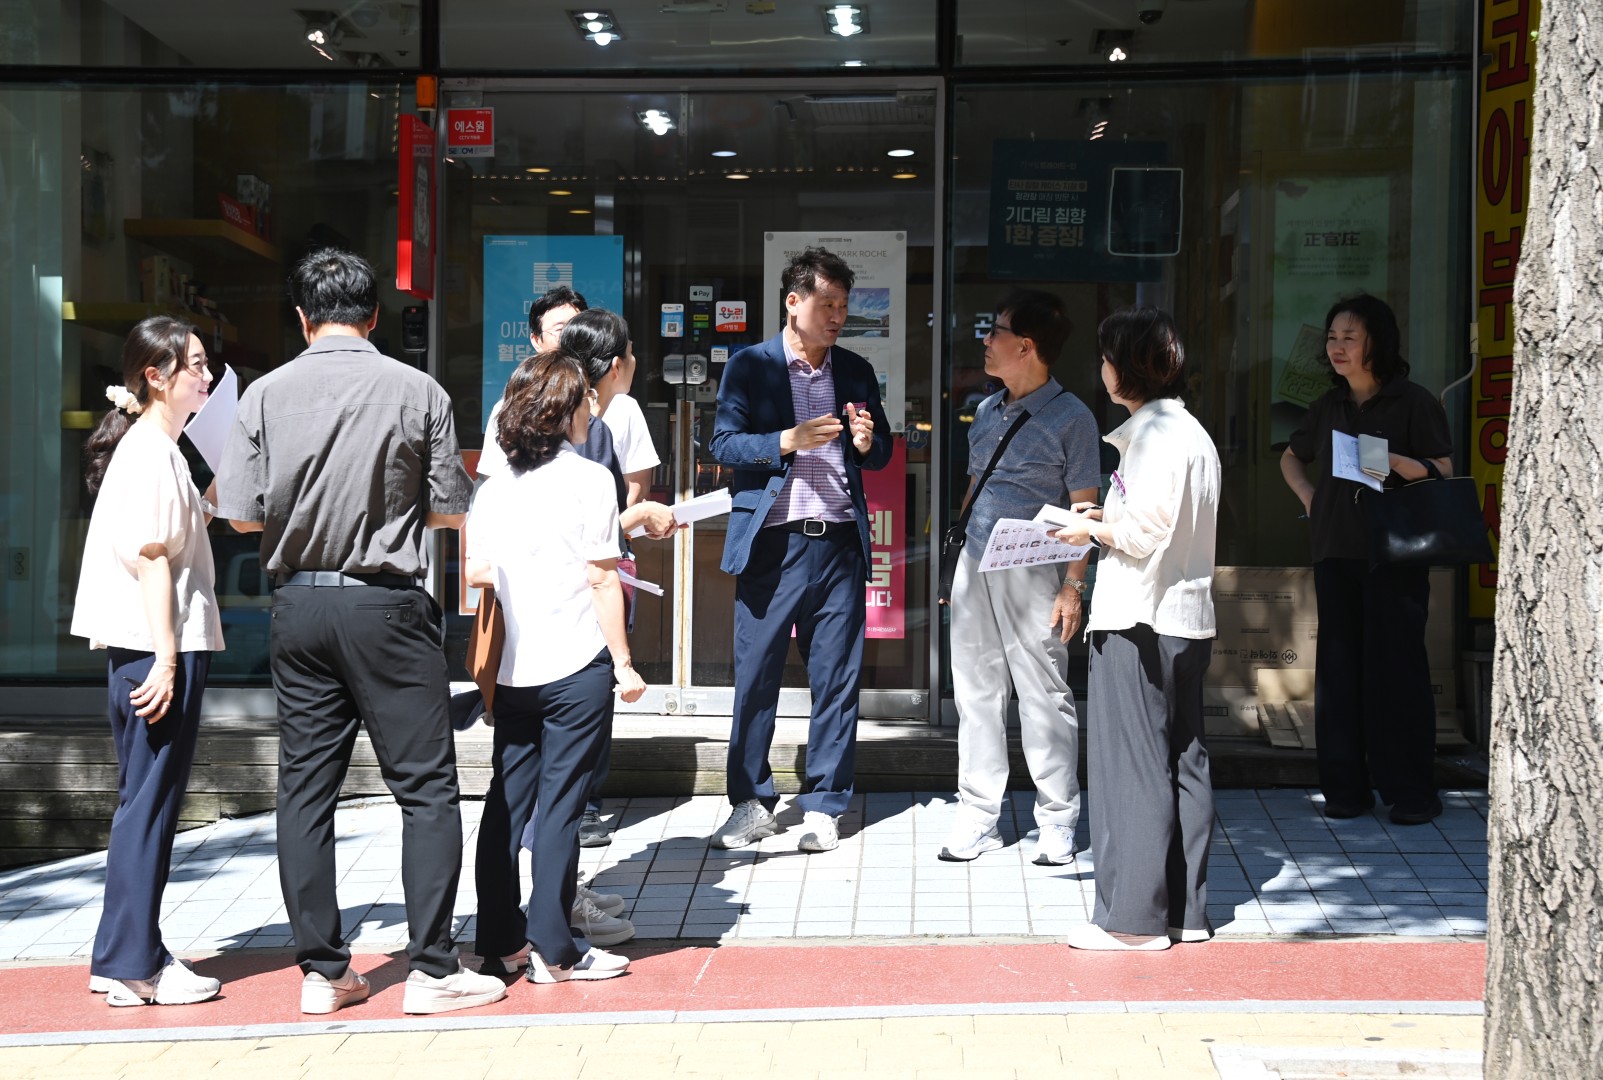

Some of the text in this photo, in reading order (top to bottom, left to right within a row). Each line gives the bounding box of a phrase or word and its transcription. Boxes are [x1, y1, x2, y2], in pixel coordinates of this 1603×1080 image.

[454, 120, 485, 133] 에스원
[448, 147, 474, 155] SEOM
[1005, 206, 1087, 224] 기다림 침향
[1004, 224, 1085, 248] 1환 증정!
[1303, 232, 1361, 247] 正官庄
[837, 250, 858, 258] PARK
[859, 250, 887, 258] ROCHE
[698, 290, 710, 298] Pay
[497, 343, 537, 363] 혈당
[906, 429, 920, 443] 10
